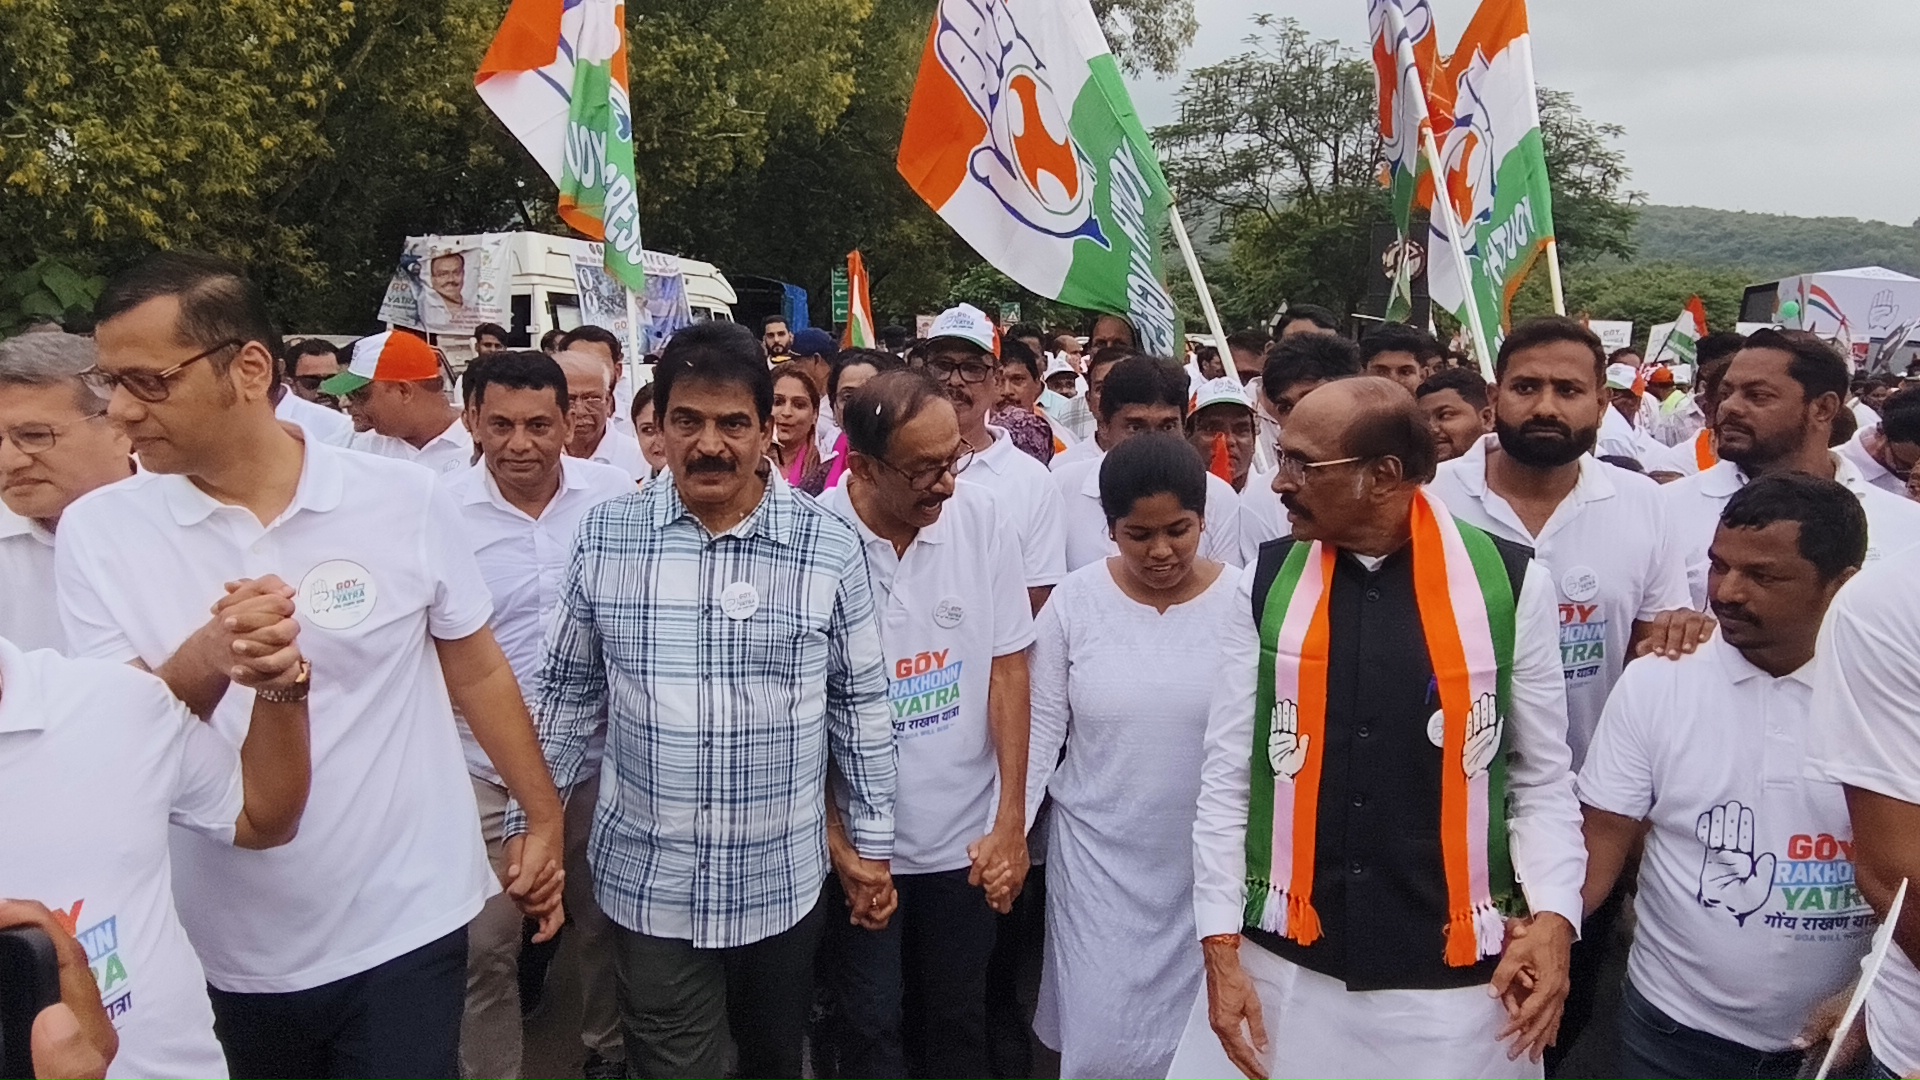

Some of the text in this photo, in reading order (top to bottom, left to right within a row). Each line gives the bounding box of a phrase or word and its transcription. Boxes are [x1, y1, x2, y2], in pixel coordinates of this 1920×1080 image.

[1559, 642, 1604, 664] TRA
[889, 663, 960, 699] RAKHONN
[893, 682, 960, 718] YATRA
[1777, 862, 1854, 883] RAKHO
[1782, 884, 1863, 910] YATR
